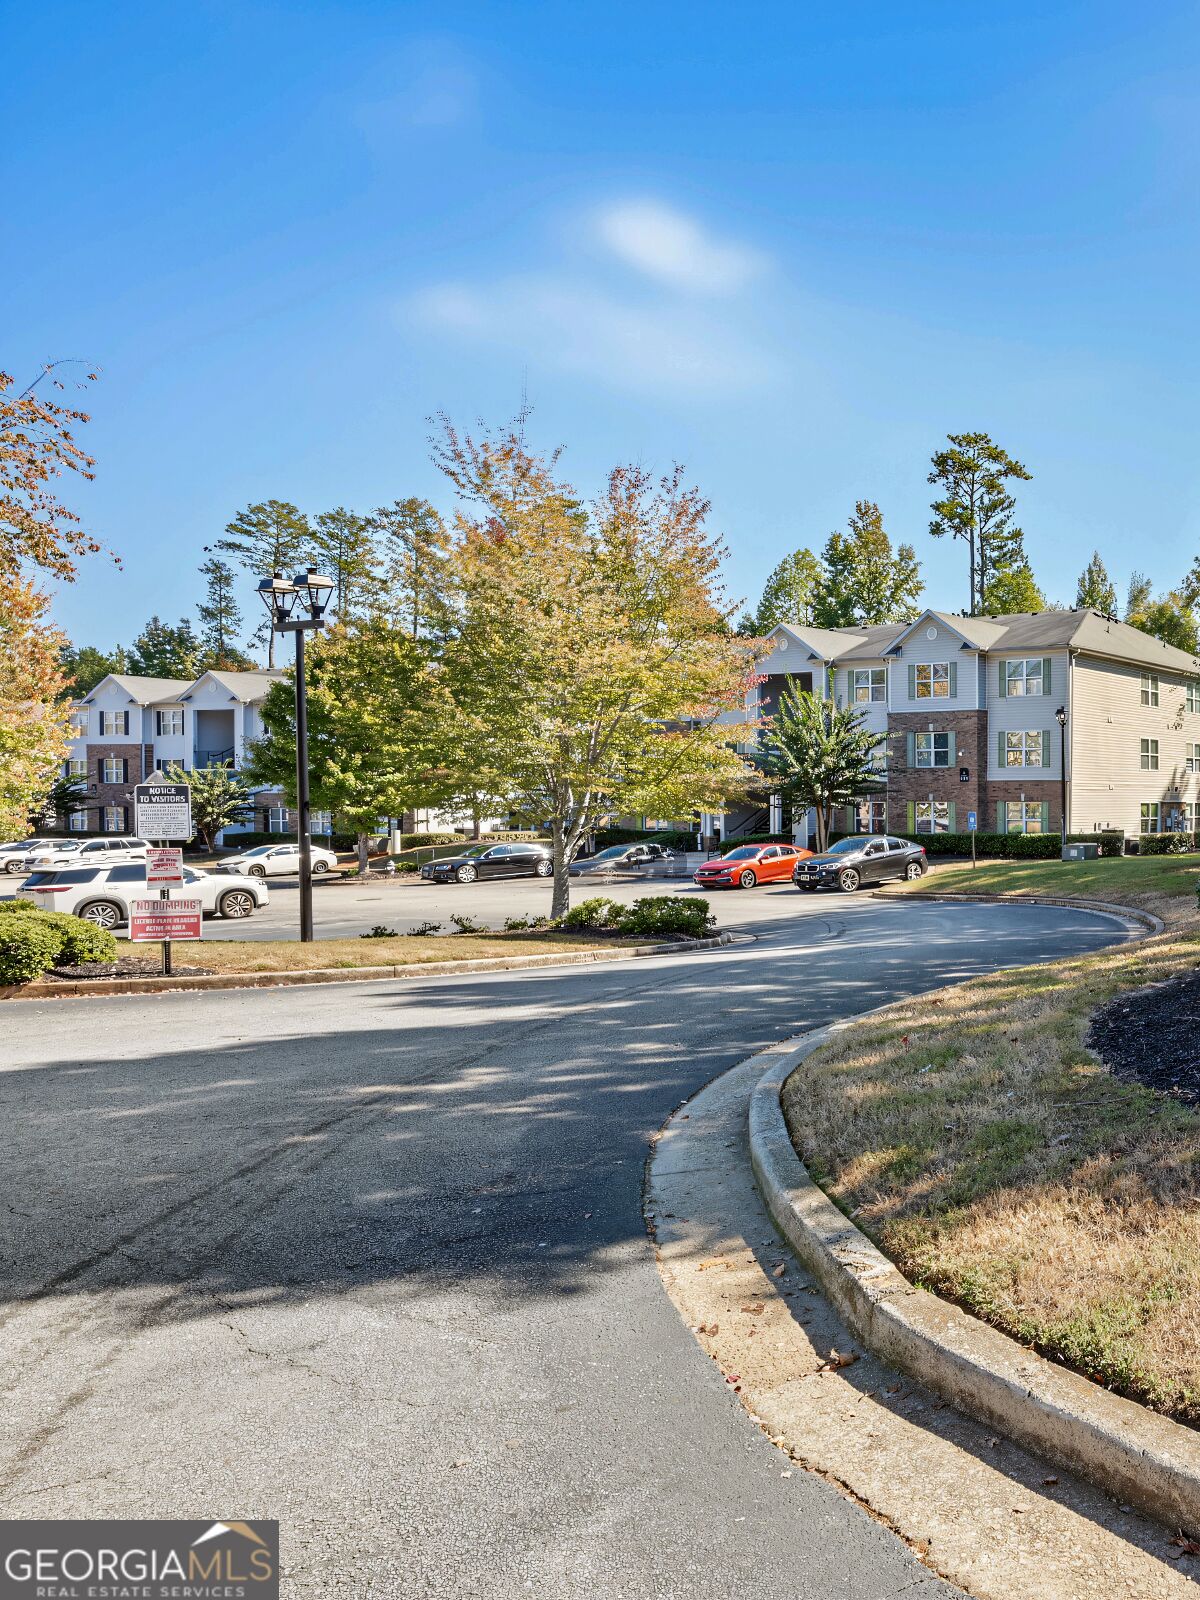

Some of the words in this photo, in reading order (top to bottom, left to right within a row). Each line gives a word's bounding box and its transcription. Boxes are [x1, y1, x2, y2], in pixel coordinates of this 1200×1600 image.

[149, 787, 177, 795] NOTICE
[136, 901, 150, 911] NO
[153, 900, 196, 911] DUMPING
